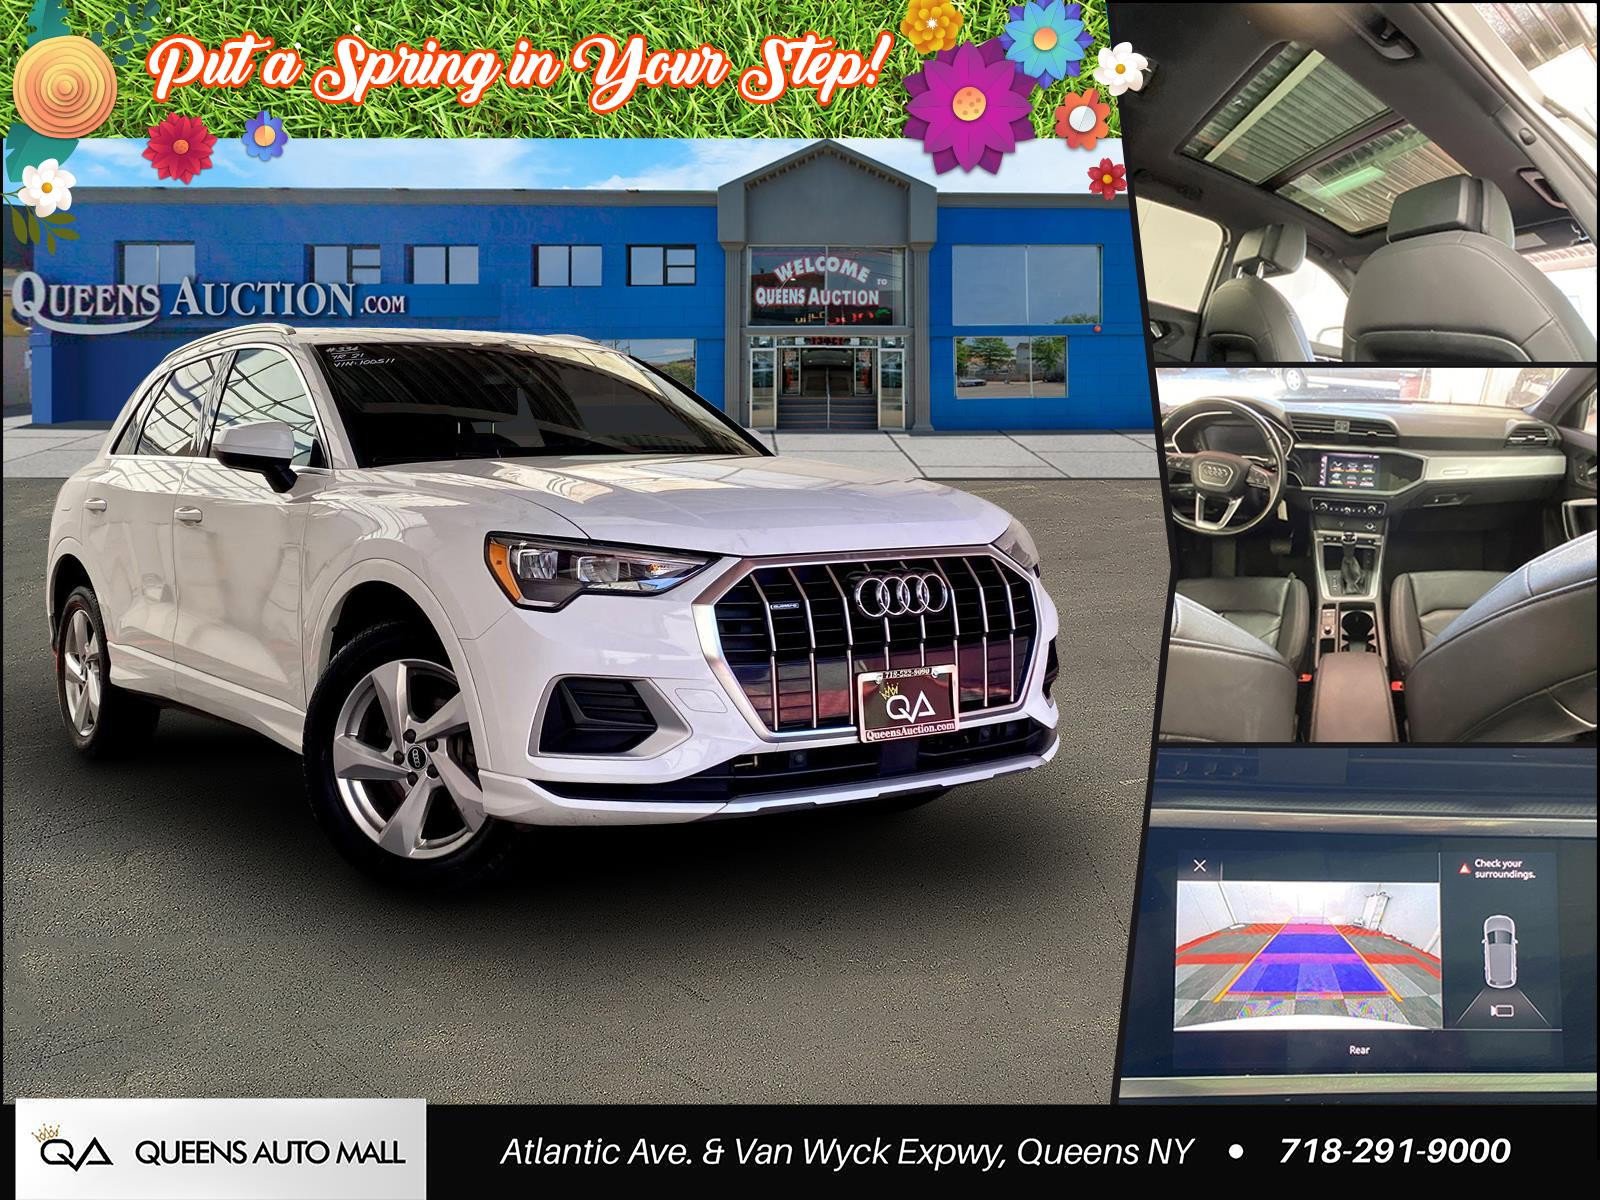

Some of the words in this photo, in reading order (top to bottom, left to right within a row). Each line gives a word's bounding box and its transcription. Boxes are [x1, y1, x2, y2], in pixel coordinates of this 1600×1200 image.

[774, 256, 870, 283] WELCOME
[877, 277, 888, 286] TO
[12, 271, 161, 335] QUEENS
[755, 287, 806, 306] QUEENS
[807, 287, 880, 306] AUCTION
[866, 721, 956, 740] QueensAuction.com
[1474, 858, 1502, 868] Check
[1502, 860, 1523, 870] your
[1474, 870, 1537, 881] surroundings.
[1349, 1045, 1370, 1056] Rear
